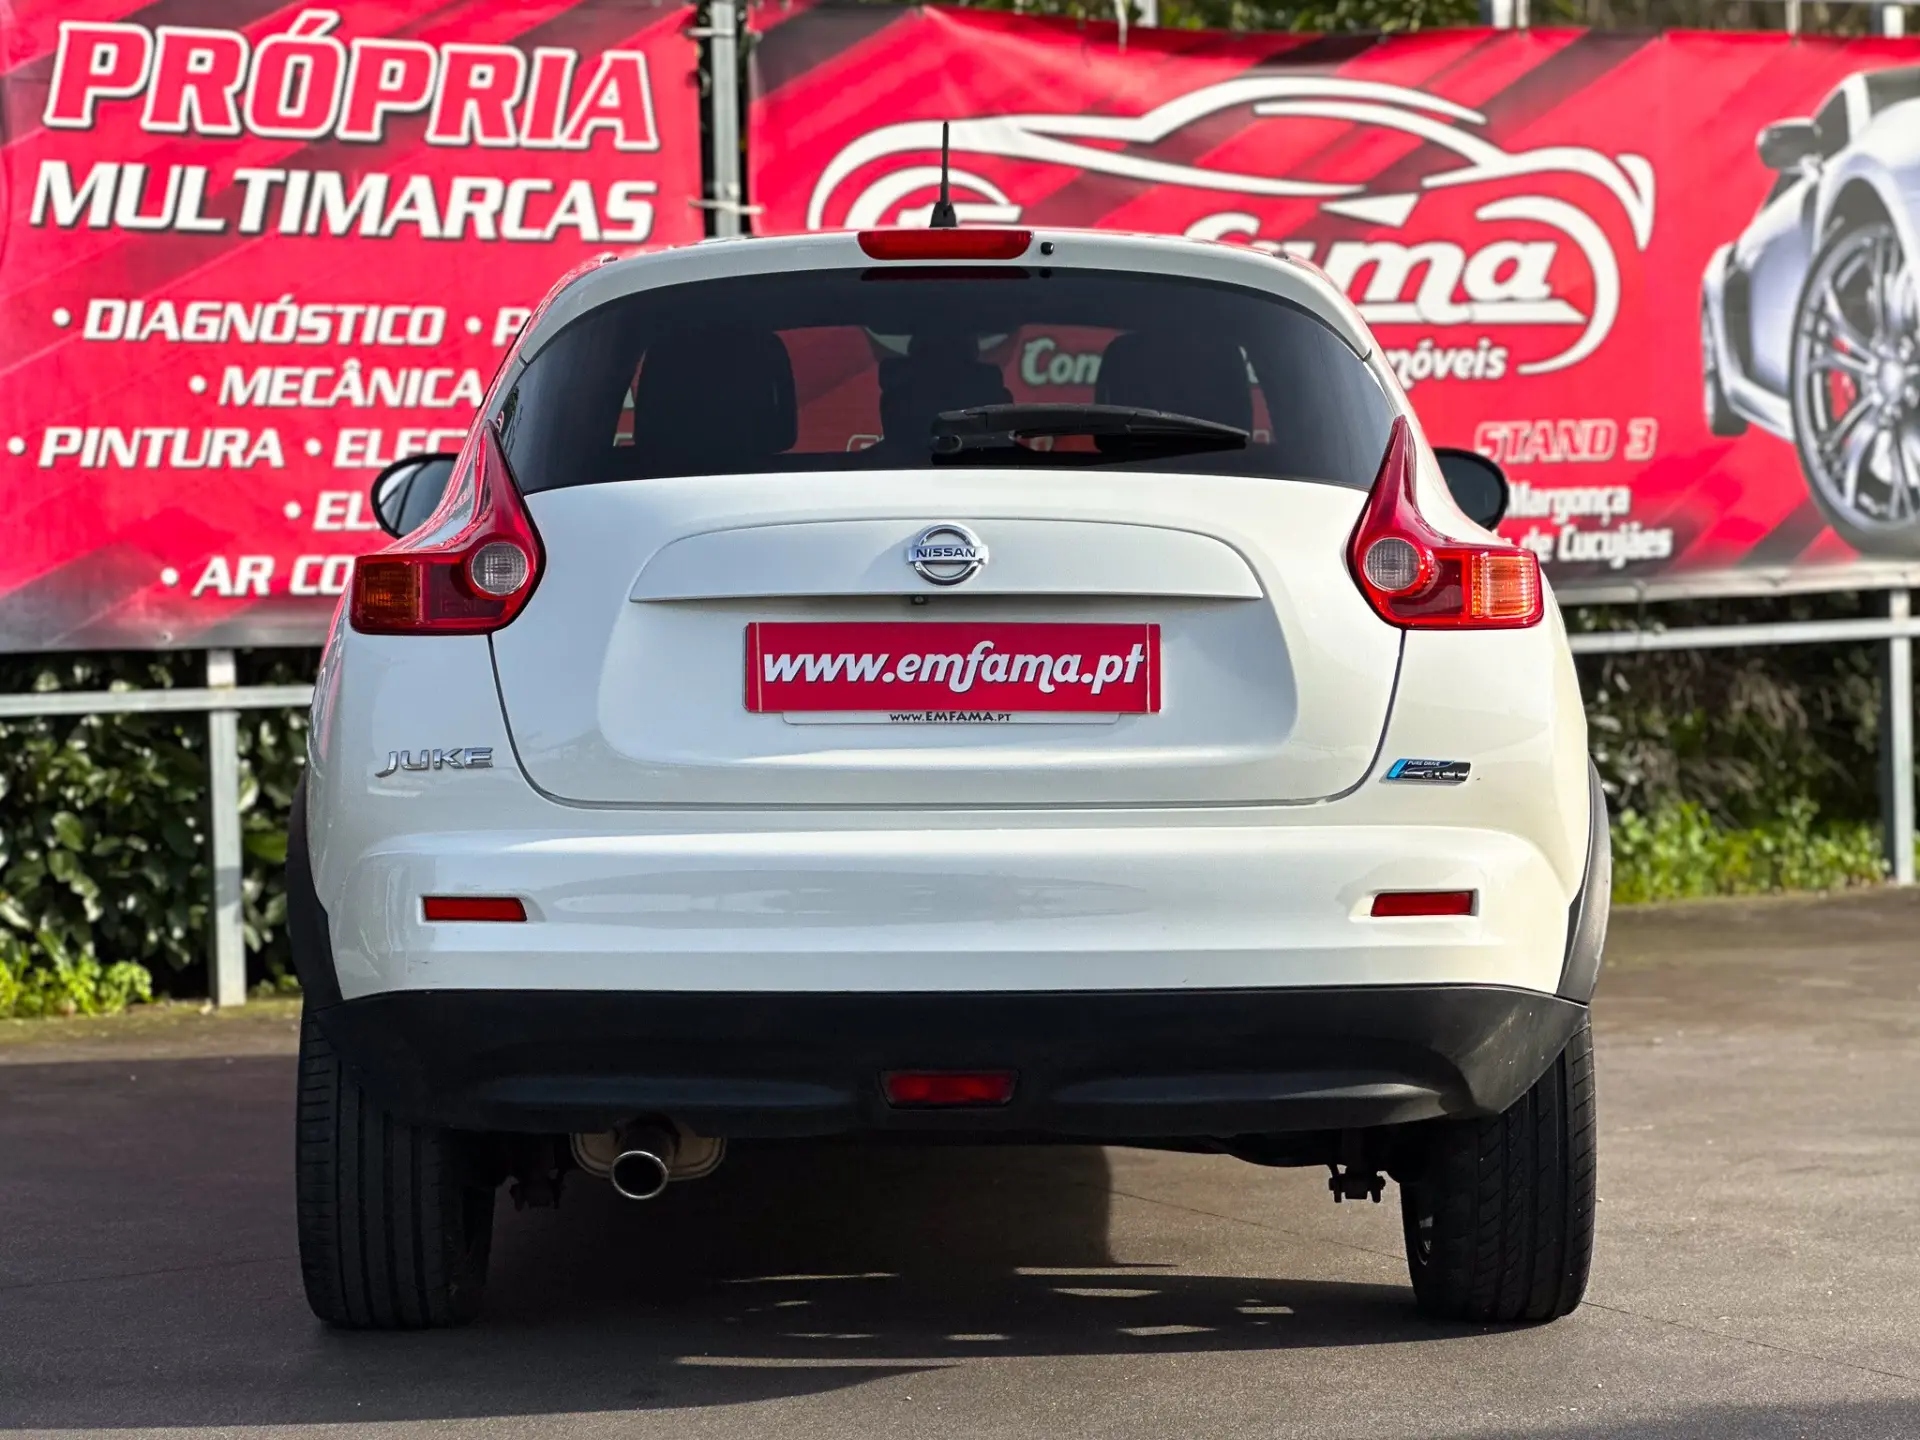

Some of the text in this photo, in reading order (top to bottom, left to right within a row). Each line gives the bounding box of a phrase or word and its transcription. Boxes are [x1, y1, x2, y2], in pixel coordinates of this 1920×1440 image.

[43, 9, 660, 150] PRÓPRIA
[29, 160, 657, 242] MULTIMARCAS
[83, 295, 446, 347] DIAGNÓSTICO
[219, 358, 484, 408] MECÂNICA
[38, 427, 284, 468] PINTURA
[1474, 417, 1659, 465] STAND 3
[313, 490, 382, 532] EL
[193, 557, 273, 596] AR
[916, 547, 976, 558] NISSAN
[763, 641, 1144, 695] www.emfama.pt
[374, 747, 493, 778] JUKE
